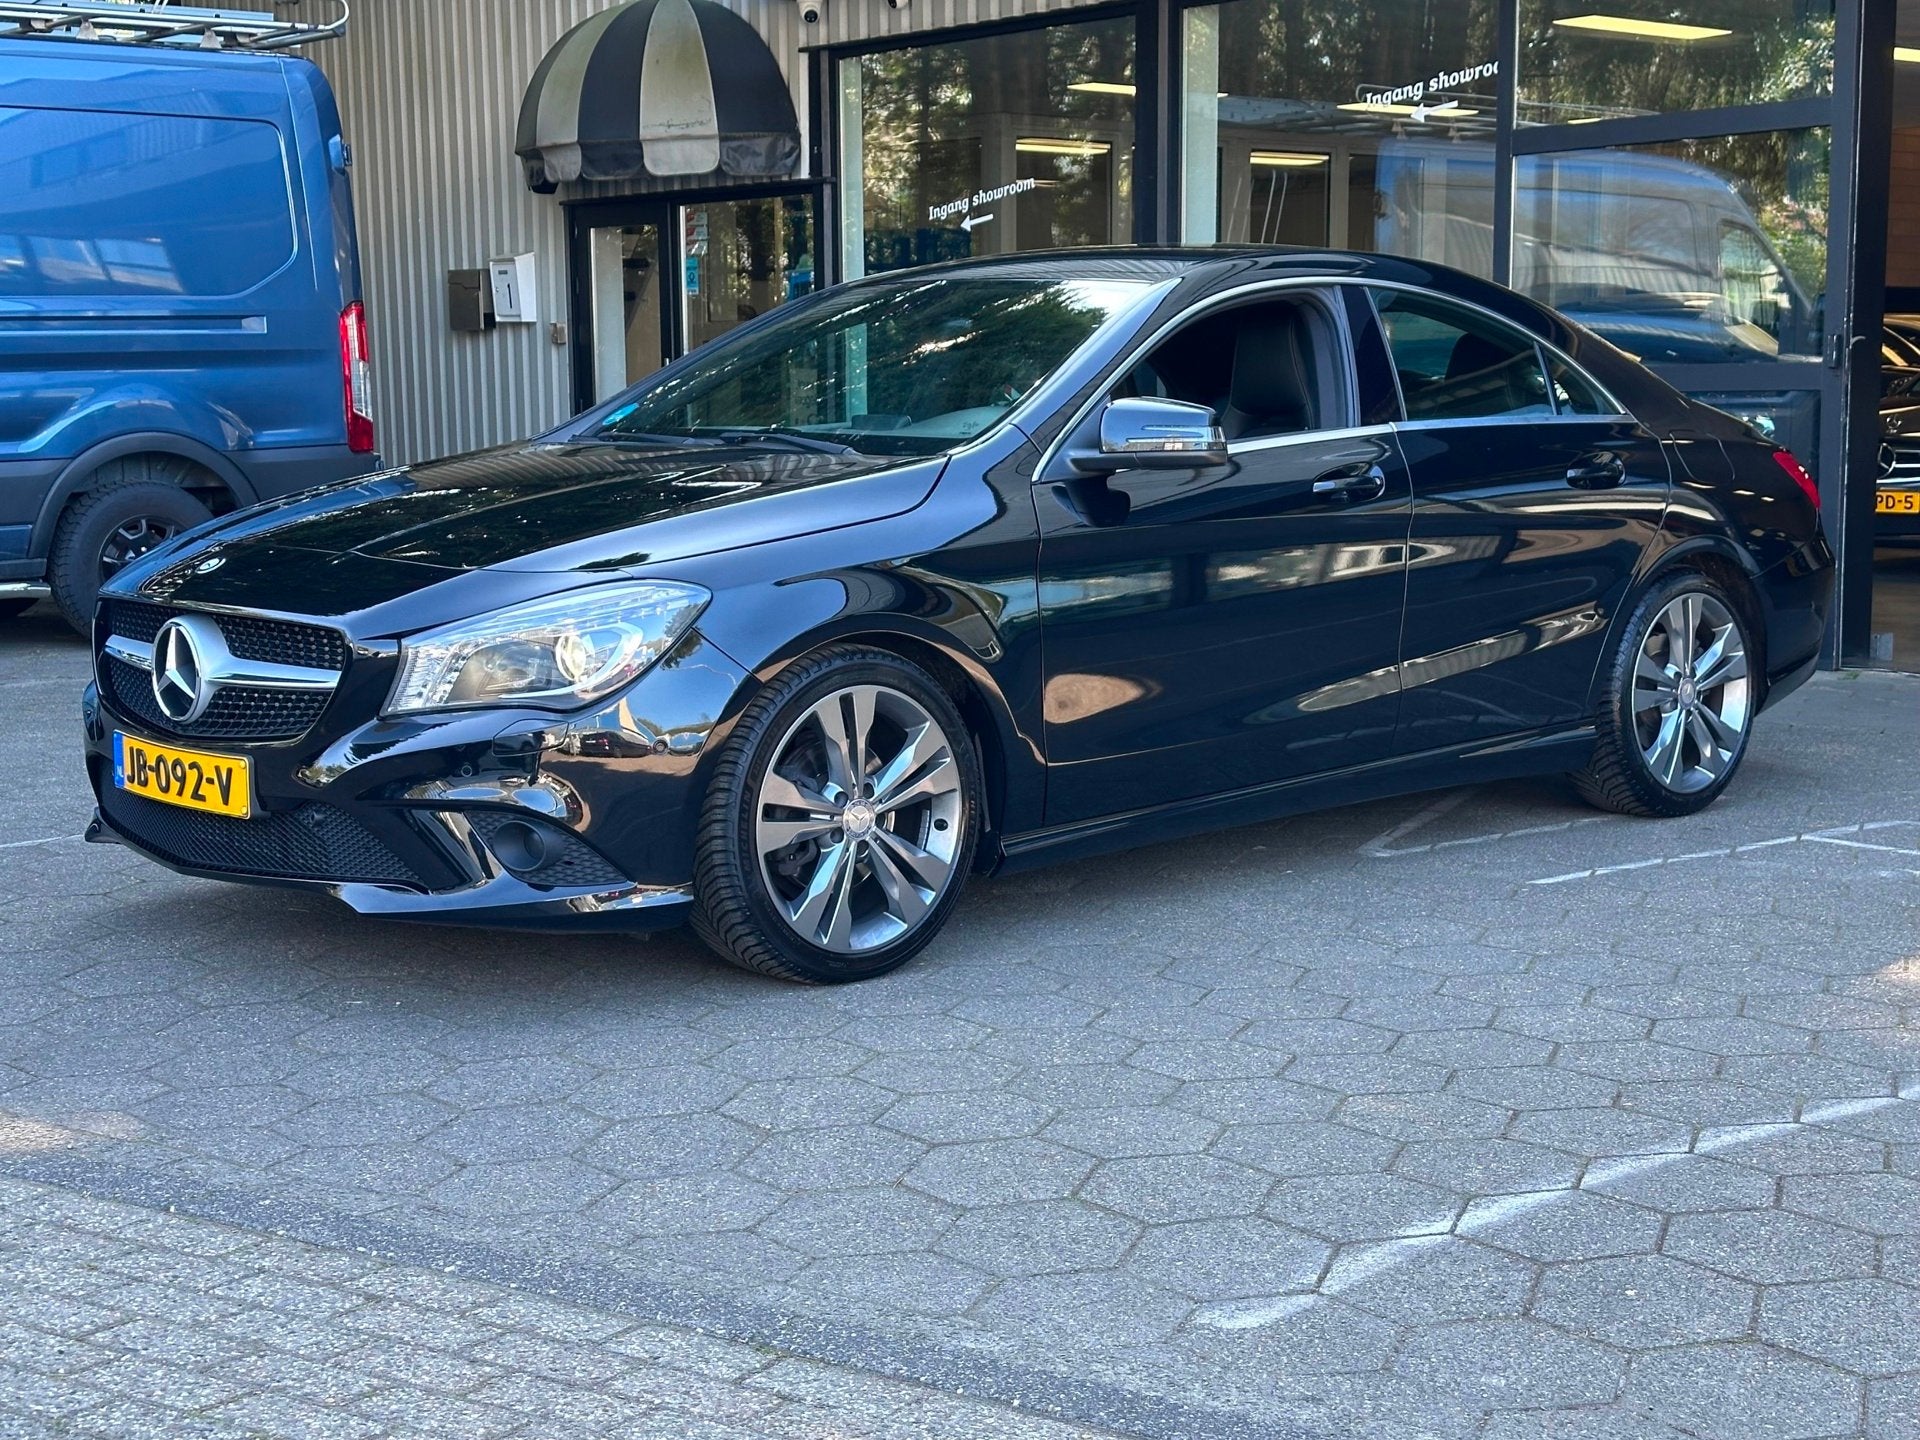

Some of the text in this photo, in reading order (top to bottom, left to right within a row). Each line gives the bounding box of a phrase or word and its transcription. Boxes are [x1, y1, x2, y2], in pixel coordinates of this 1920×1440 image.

[1366, 82, 1424, 107] Ingang
[928, 178, 1036, 220] Ingang showroom
[127, 746, 233, 806] JB-092-V
